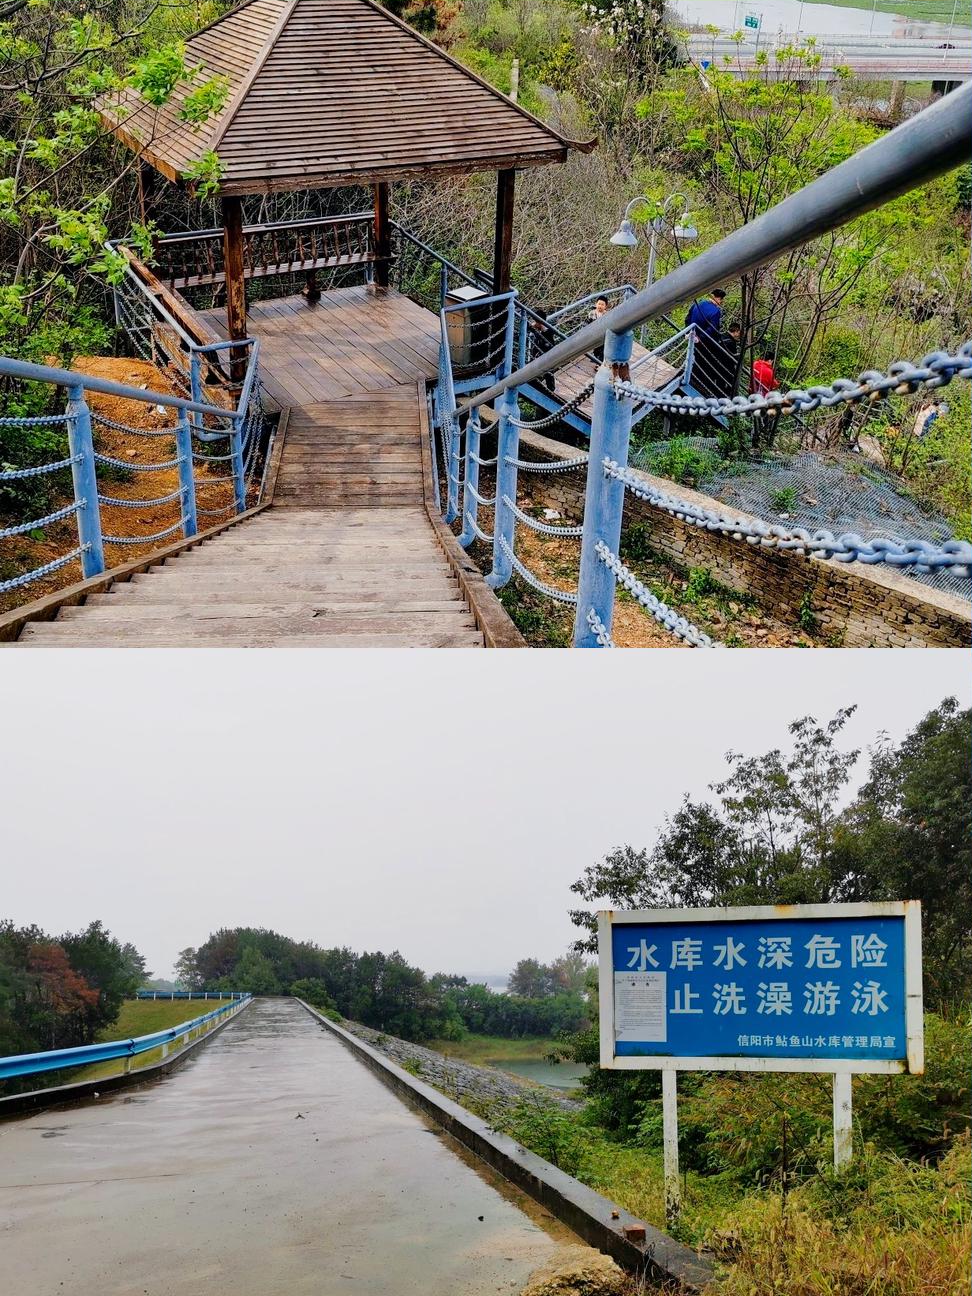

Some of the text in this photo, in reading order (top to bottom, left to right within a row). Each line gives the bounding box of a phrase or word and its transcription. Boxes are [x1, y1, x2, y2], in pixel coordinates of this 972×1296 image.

[627, 933, 888, 972] 水库水深危险
[669, 981, 890, 1016] 止洗澡游泳
